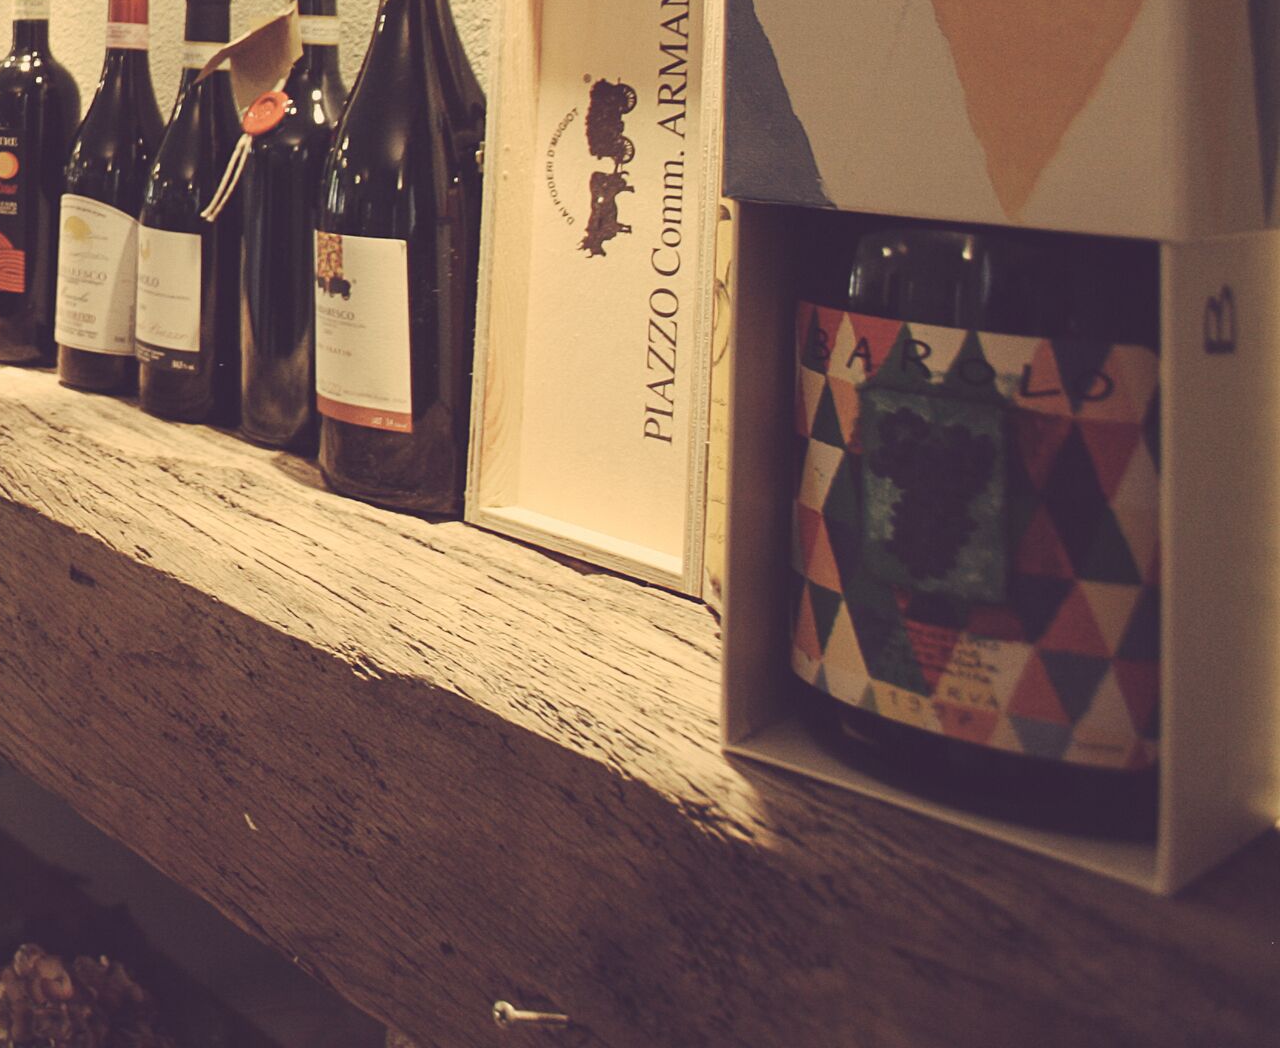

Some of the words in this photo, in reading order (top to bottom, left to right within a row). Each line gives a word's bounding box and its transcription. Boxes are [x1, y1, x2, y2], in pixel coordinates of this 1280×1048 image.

[546, 160, 561, 205] PODERI
[558, 207, 575, 226] DAI
[651, 150, 686, 277] Comm.
[1203, 283, 1238, 354] B
[643, 287, 680, 446] PIAZZO
[813, 326, 1115, 403] BAROLO
